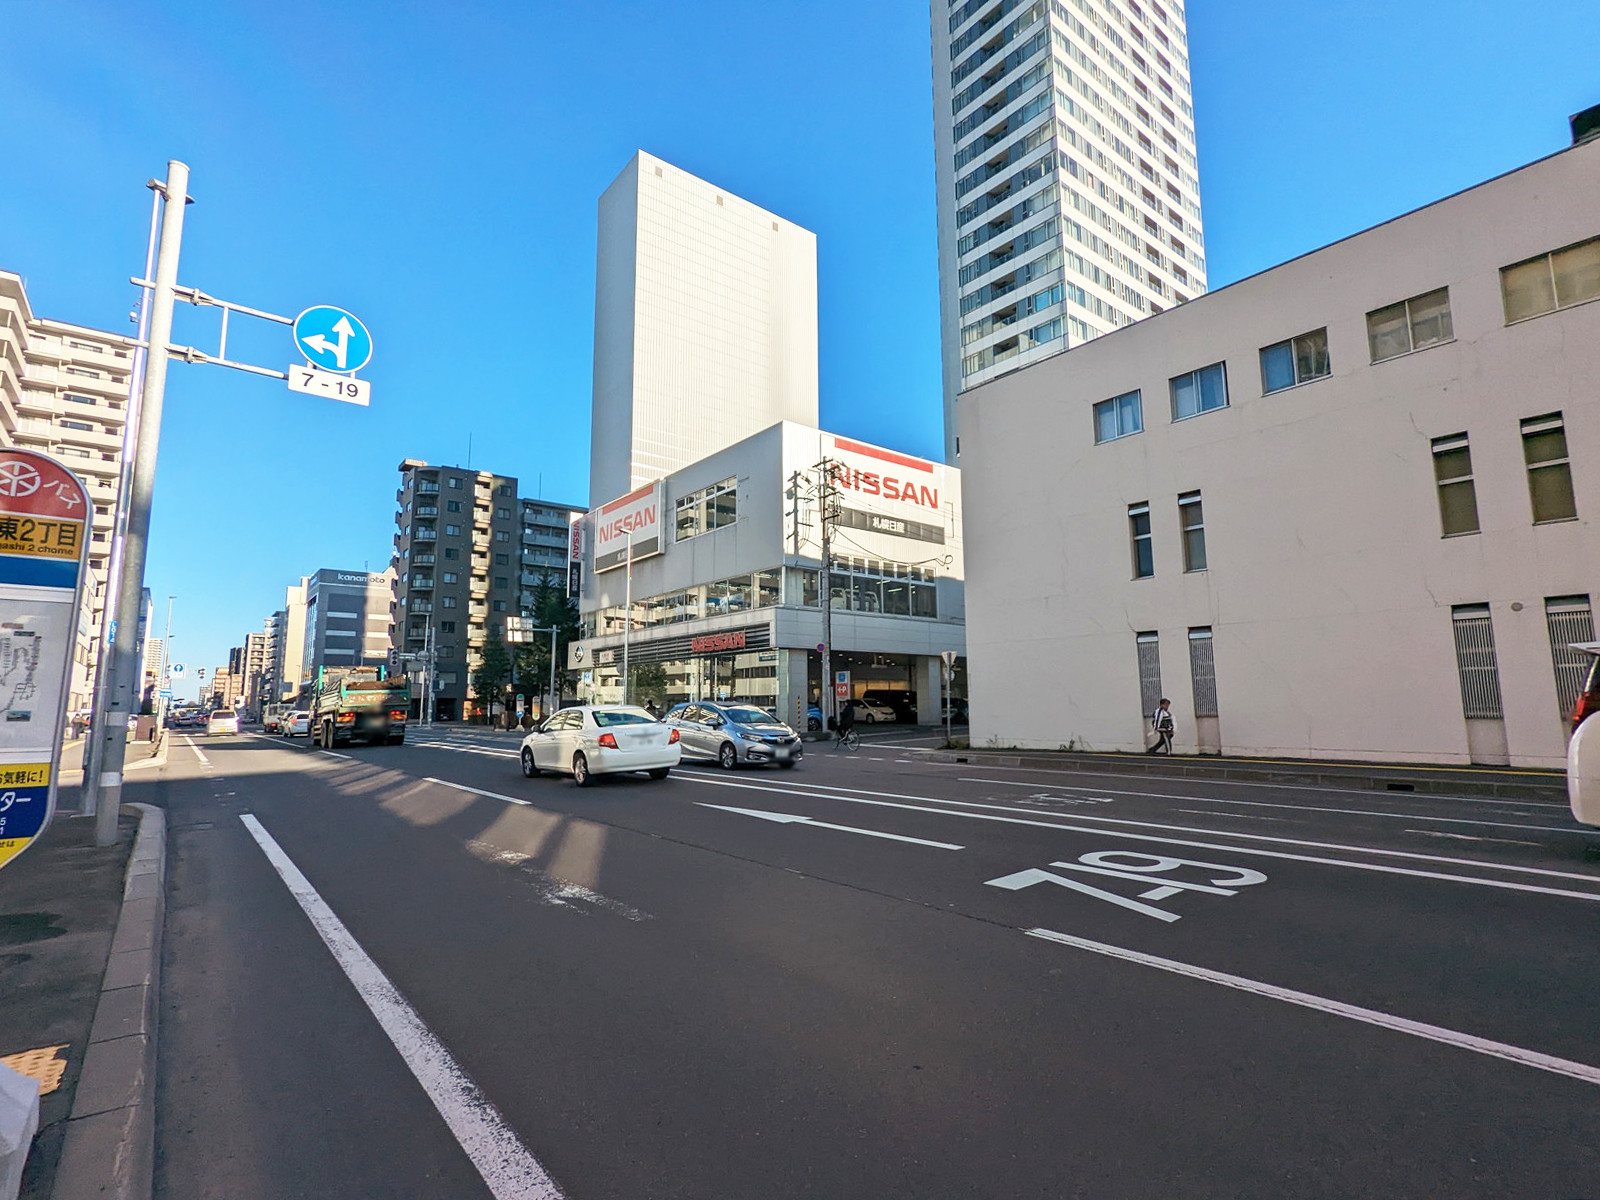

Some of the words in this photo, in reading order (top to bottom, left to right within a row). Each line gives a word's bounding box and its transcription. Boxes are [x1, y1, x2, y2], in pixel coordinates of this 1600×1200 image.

[43, 480, 82, 509] バス
[829, 463, 939, 510] NISSAN
[572, 521, 580, 560] NISSAN
[598, 503, 656, 545] NISSAN
[27, 544, 35, 552] 2
[37, 545, 74, 555] chome
[691, 631, 746, 653] NISSAN
